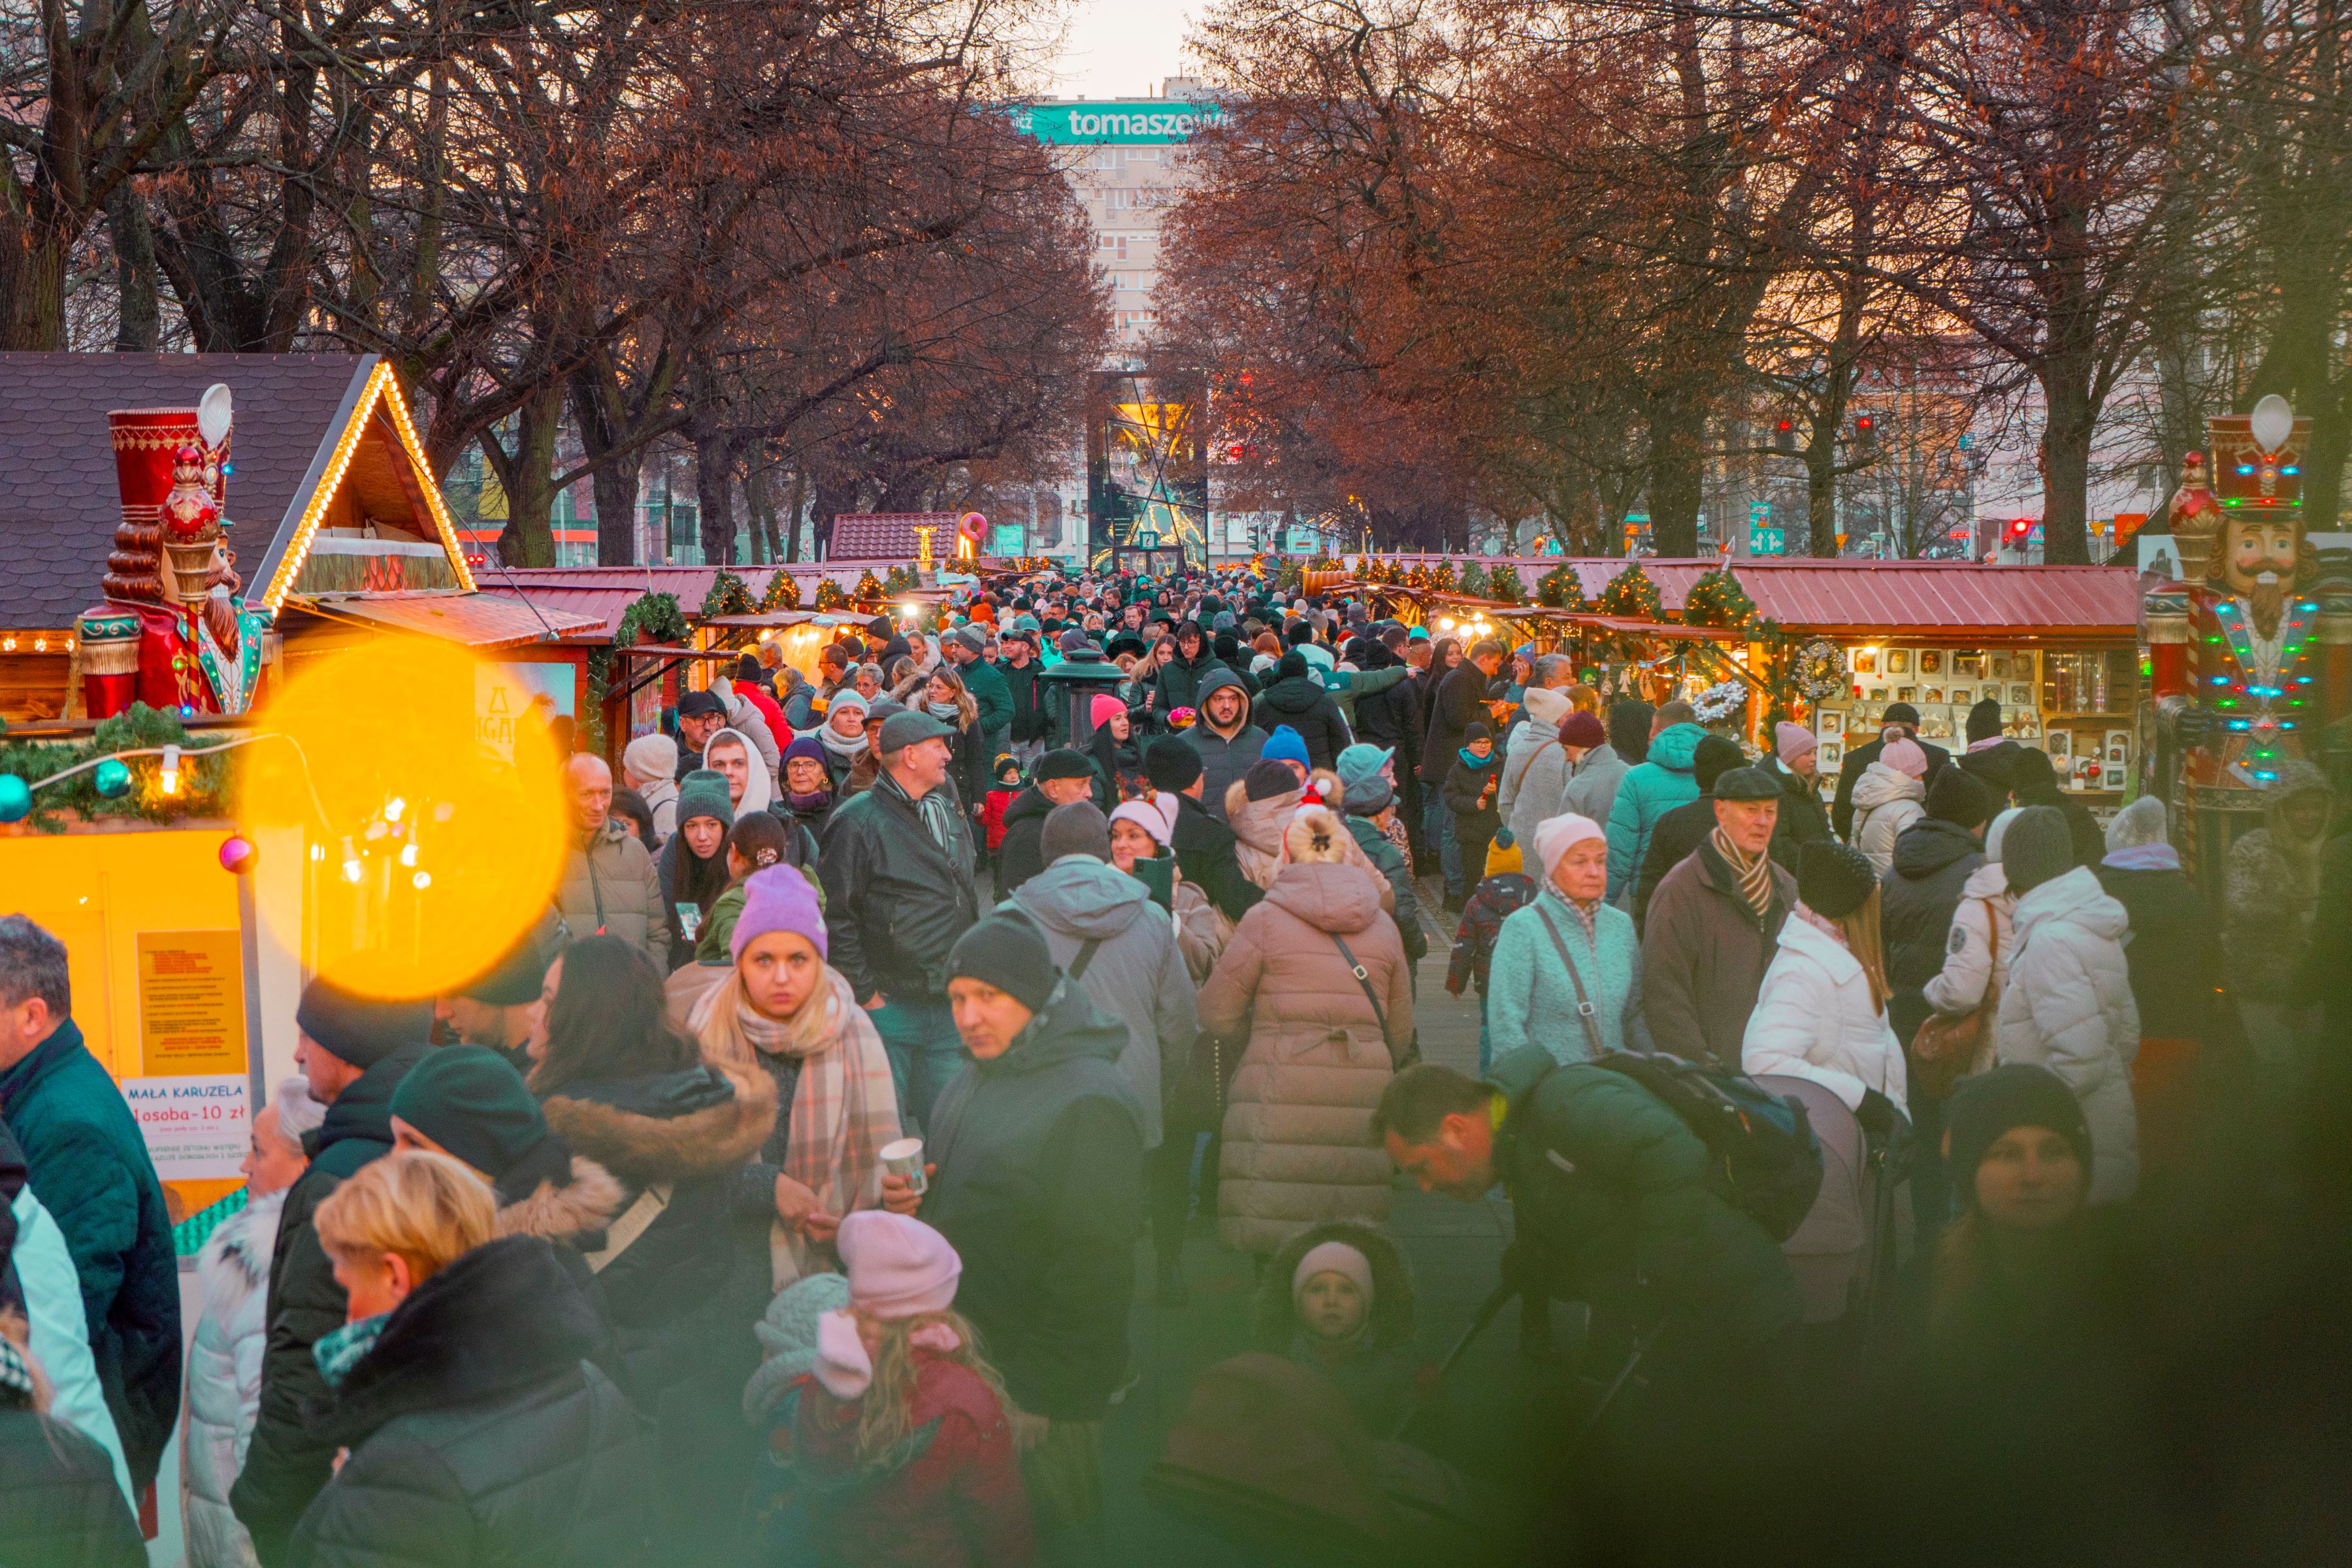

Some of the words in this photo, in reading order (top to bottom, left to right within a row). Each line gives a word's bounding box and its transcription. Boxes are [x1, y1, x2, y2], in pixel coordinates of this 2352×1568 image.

[129, 1088, 167, 1100] MAŁA
[172, 1085, 243, 1099] KARUZELA
[229, 1104, 246, 1120] zł
